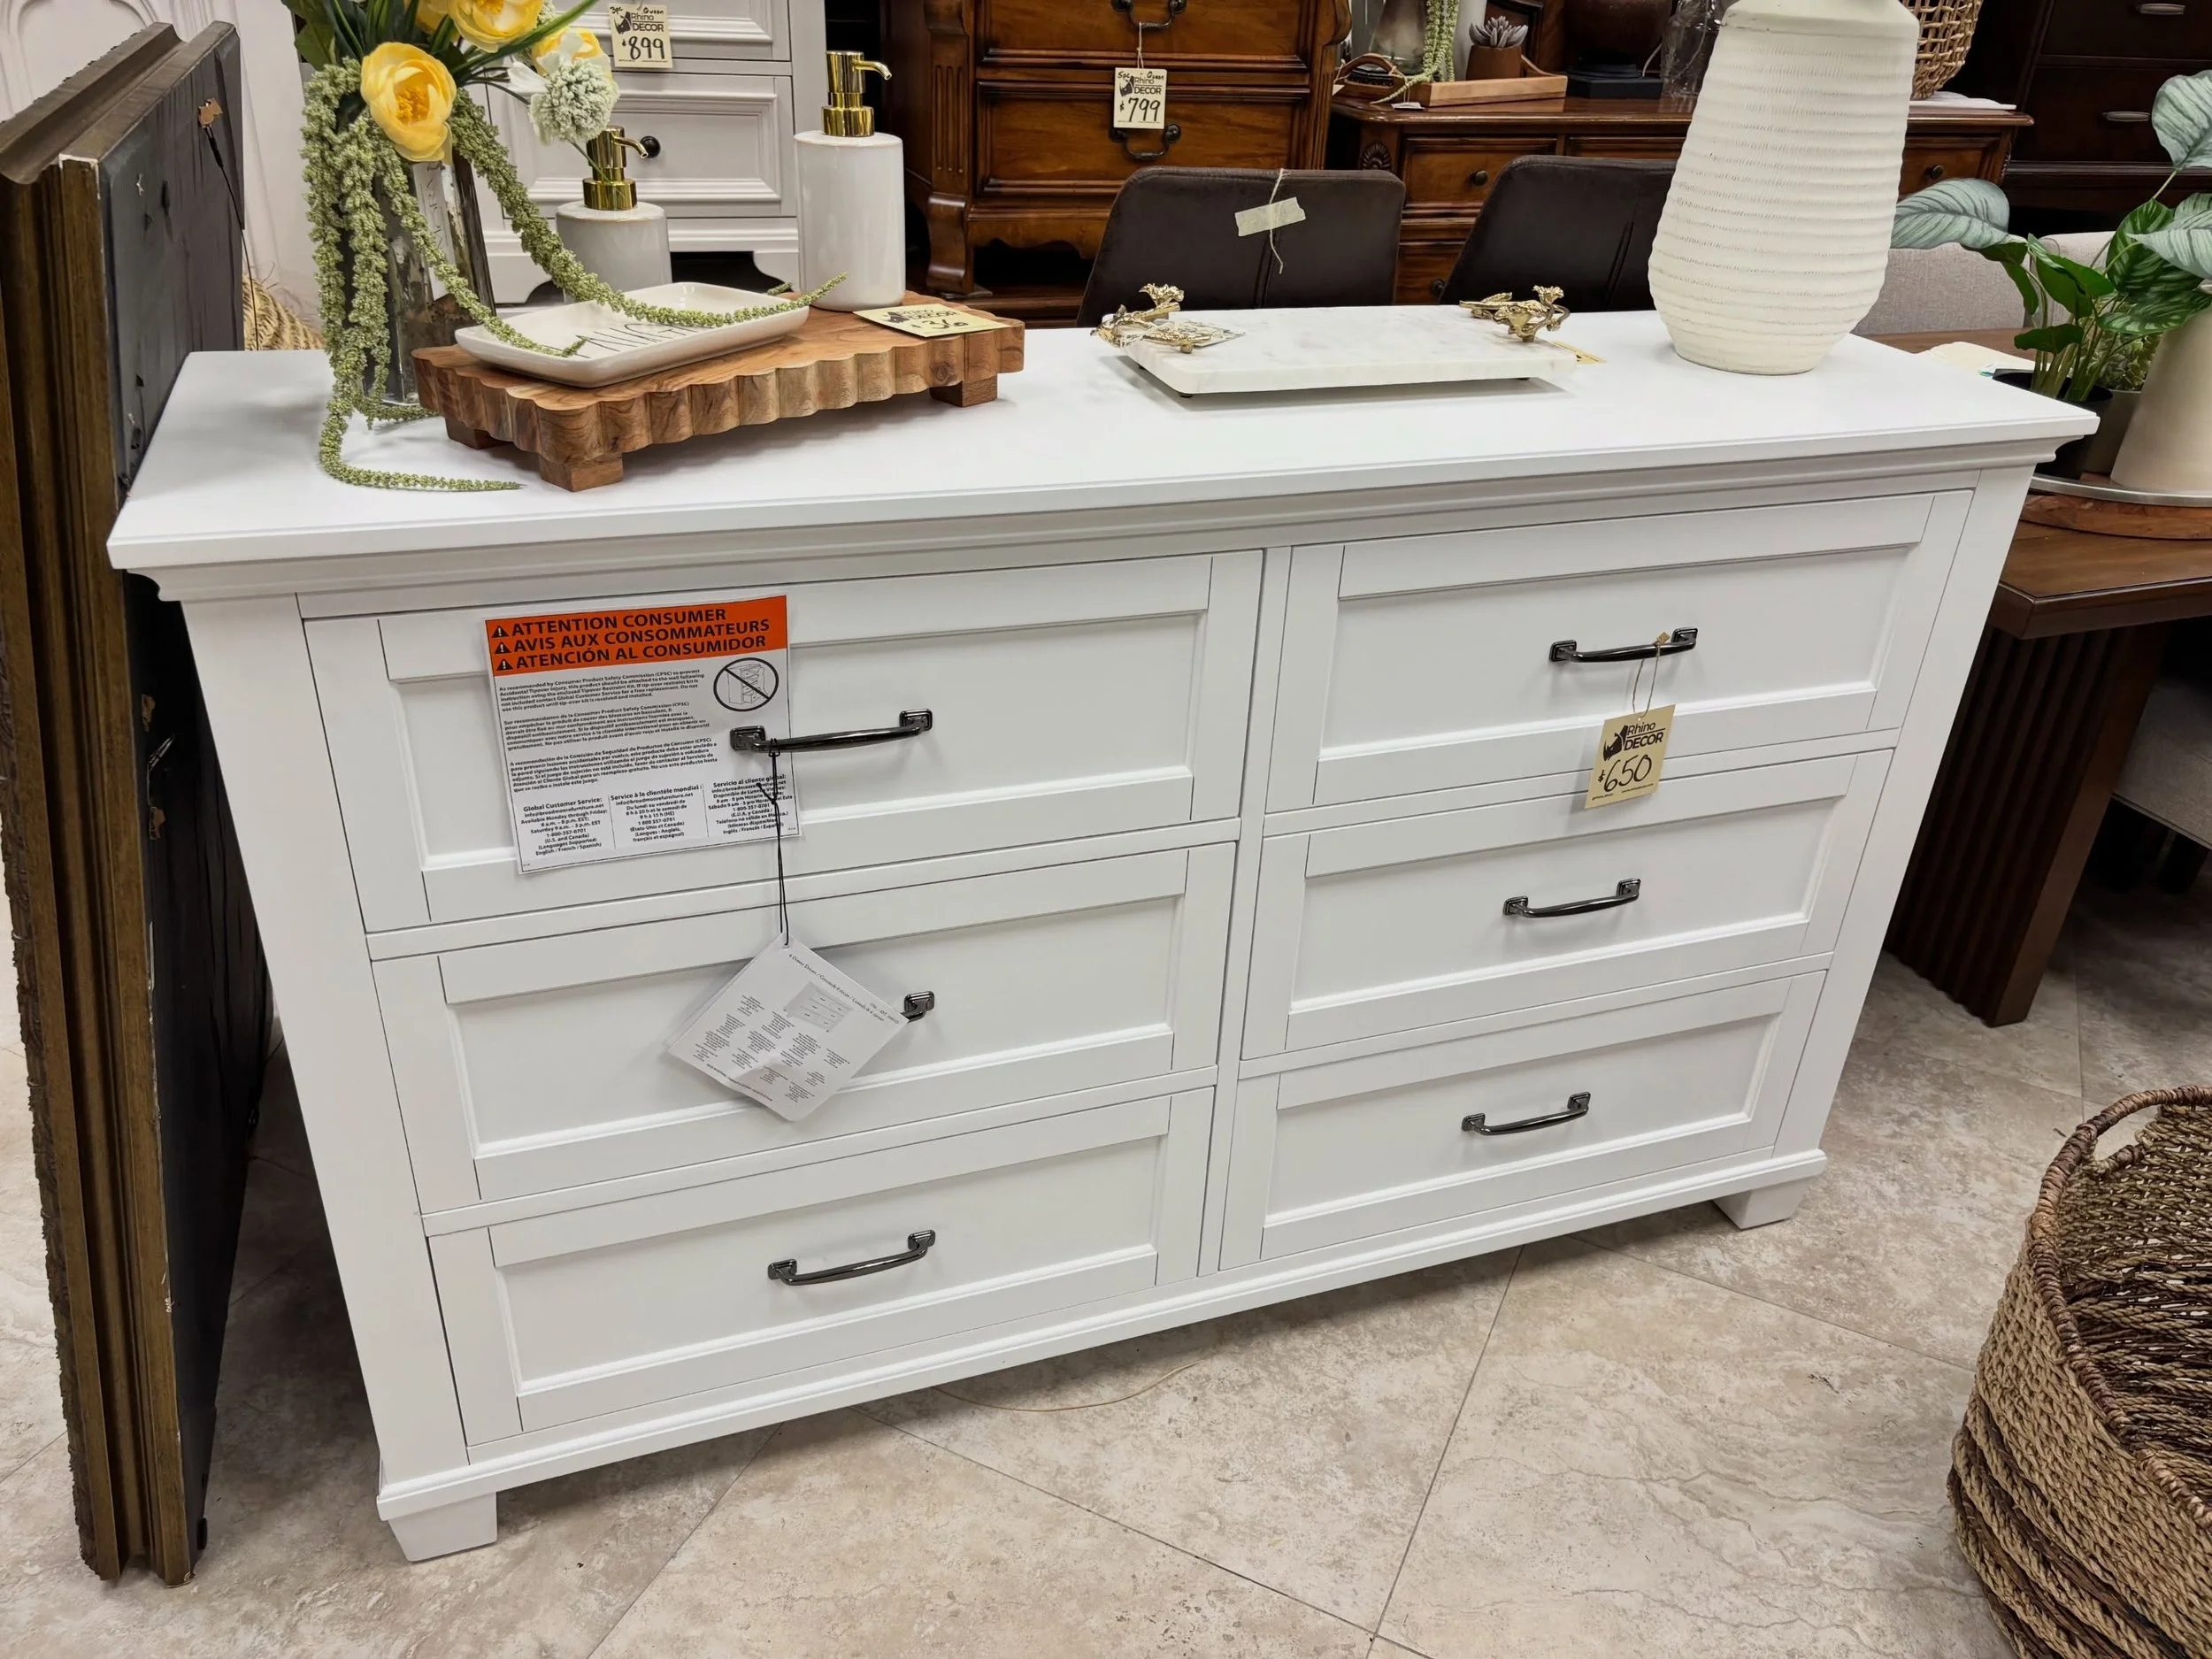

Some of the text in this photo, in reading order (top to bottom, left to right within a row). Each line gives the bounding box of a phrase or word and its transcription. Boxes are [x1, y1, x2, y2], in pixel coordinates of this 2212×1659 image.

[632, 12, 654, 21] Rhino
[632, 23, 664, 32] DECOR
[512, 609, 725, 635] ATTENTION CONSUMER
[514, 619, 768, 652] AVIS AUX CONSOMMATEURS
[516, 635, 764, 668] ATENCIÓN AL CONSUMIDOR
[1627, 722, 1655, 734] Rhino
[1624, 732, 1663, 750] DECOR
[1598, 755, 1652, 792] $650
